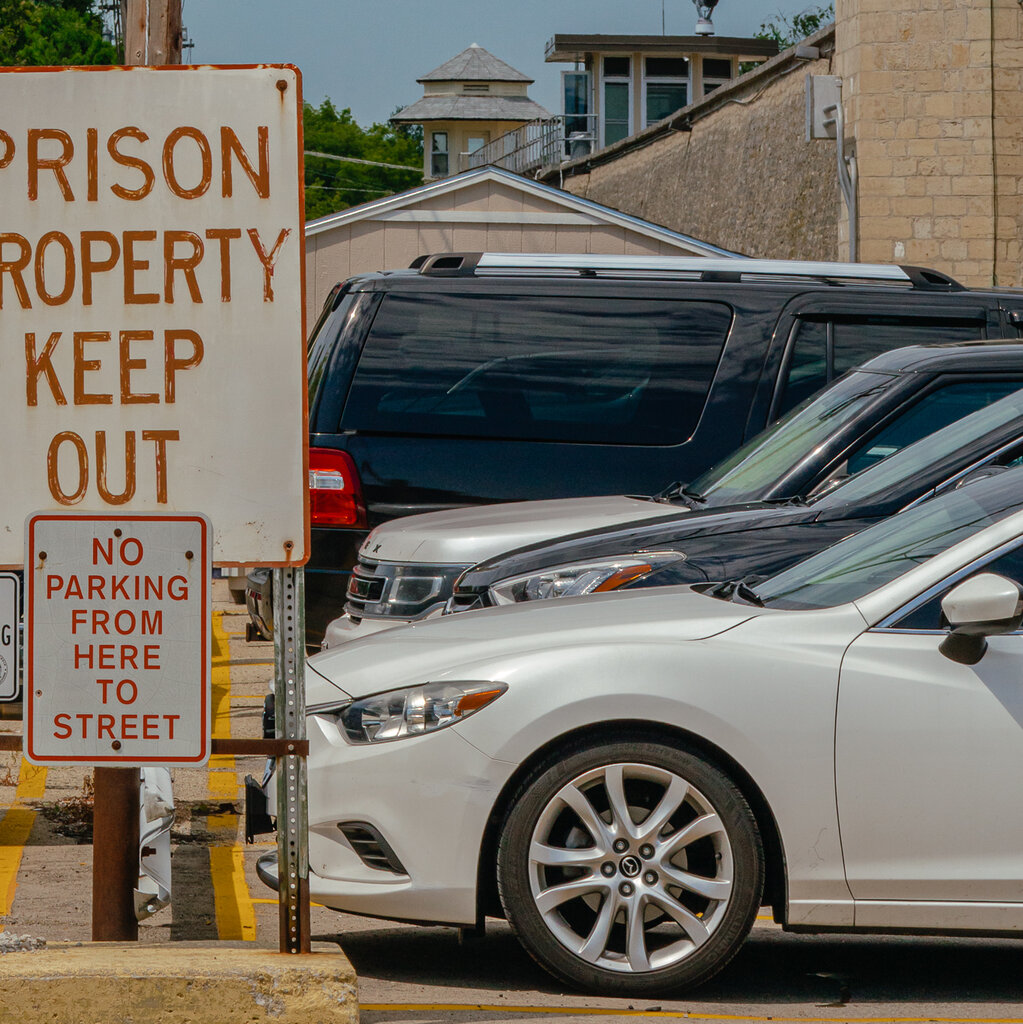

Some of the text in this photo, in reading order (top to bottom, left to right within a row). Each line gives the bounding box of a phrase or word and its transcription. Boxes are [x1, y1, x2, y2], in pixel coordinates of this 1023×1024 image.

[24, 329, 205, 407] KEEP
[46, 429, 180, 506] OUT
[92, 537, 144, 566] NO
[46, 574, 189, 601] PARKING
[71, 609, 163, 636] FROM
[74, 644, 161, 670] HERE
[96, 679, 138, 705] TO
[53, 713, 180, 740] STREET
